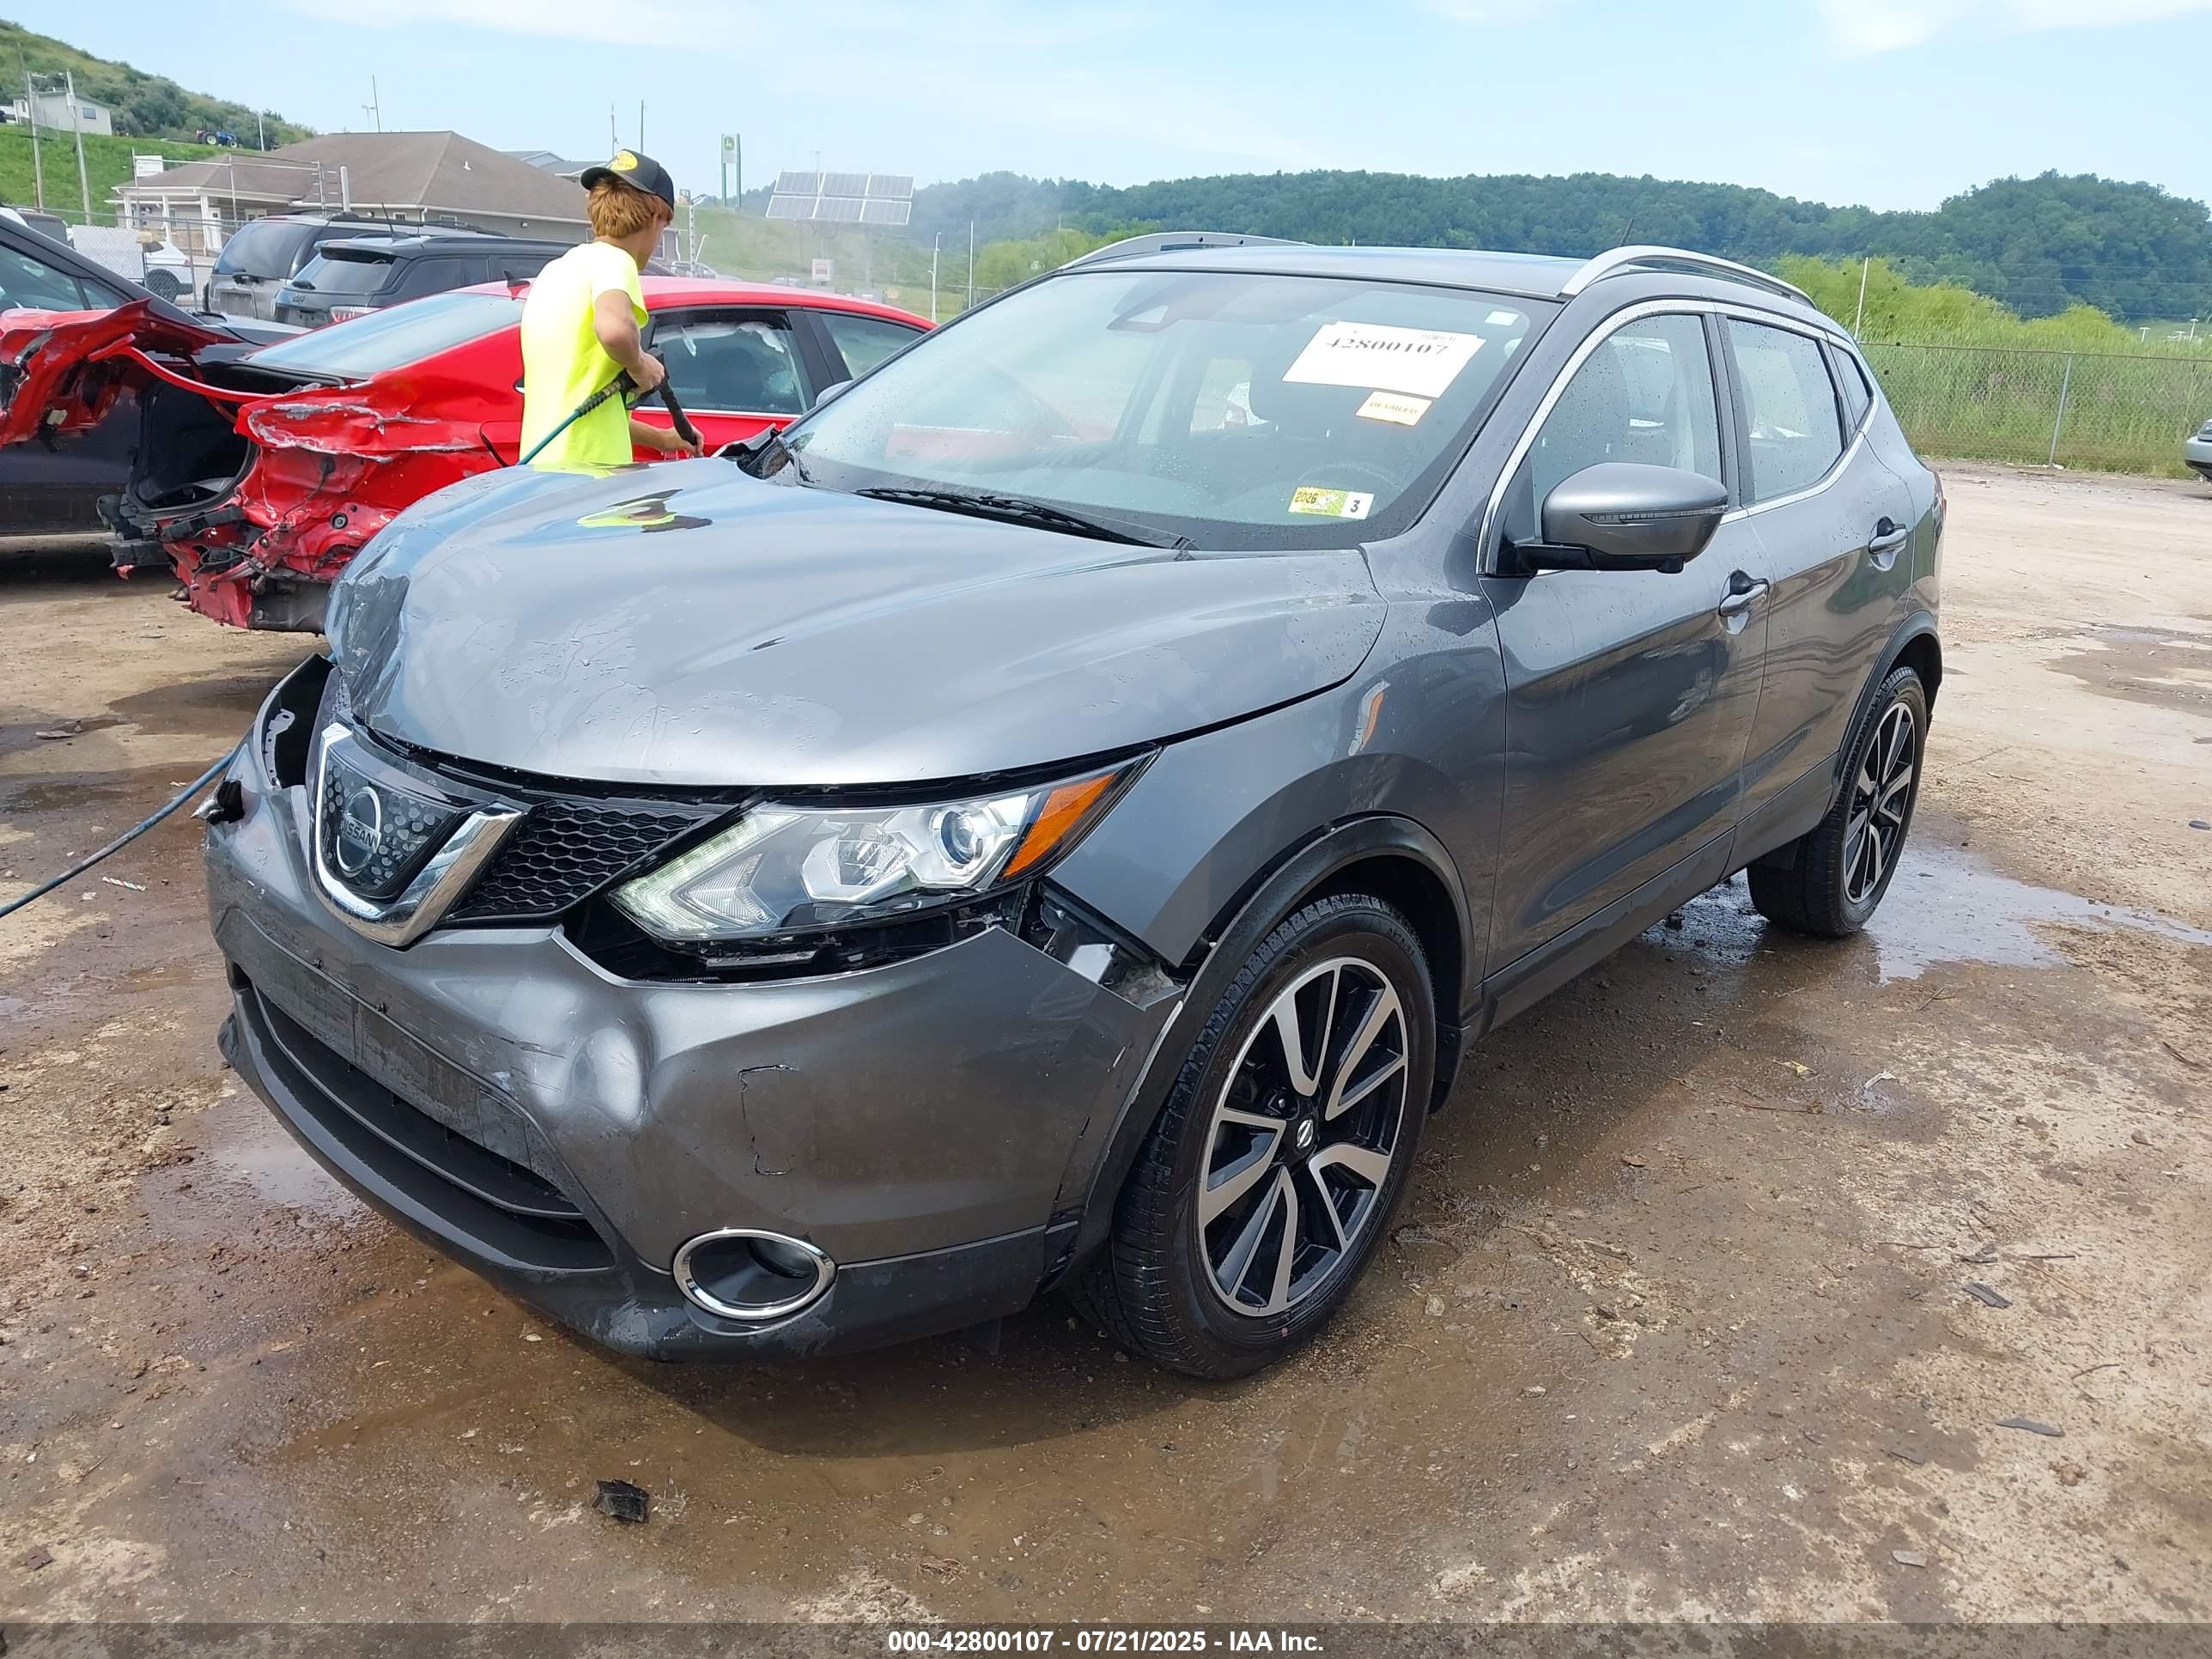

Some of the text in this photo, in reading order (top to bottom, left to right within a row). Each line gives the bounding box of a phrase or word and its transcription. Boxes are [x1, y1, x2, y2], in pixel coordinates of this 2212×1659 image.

[1326, 337, 1449, 355] 42800107
[1294, 492, 1318, 504] 2026
[1350, 500, 1361, 513] 3
[340, 819, 374, 847] NISSAN
